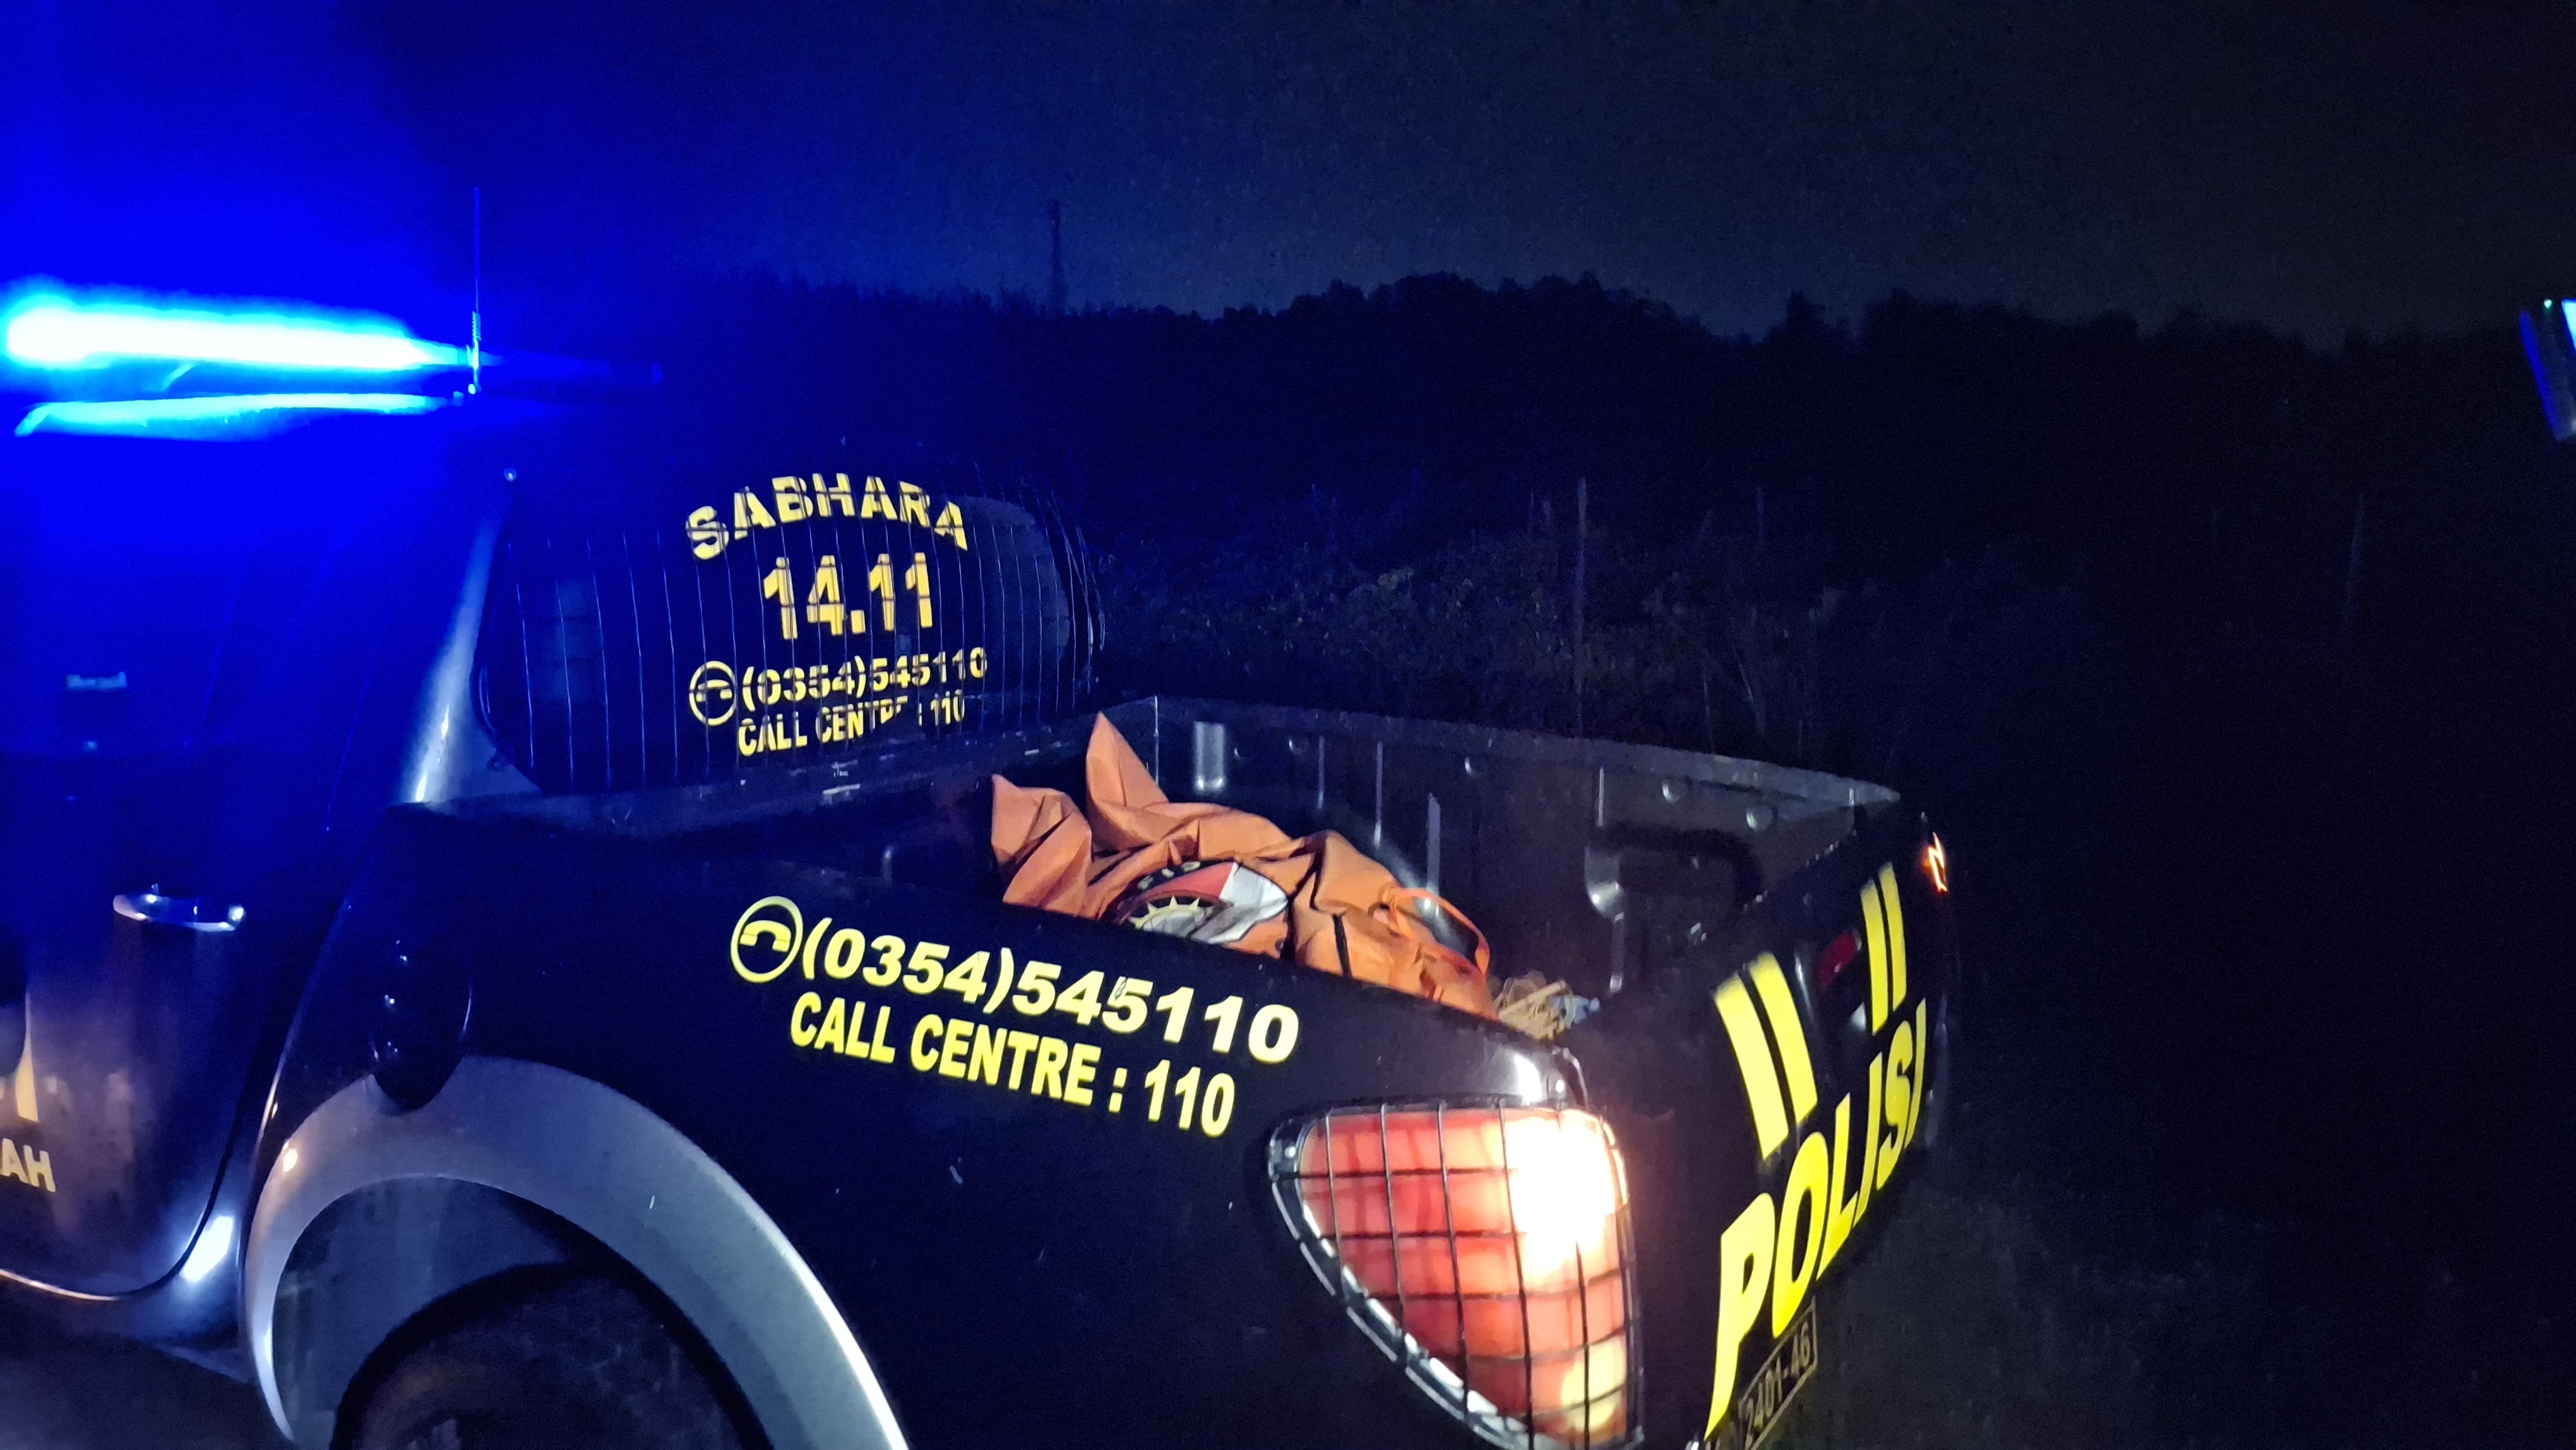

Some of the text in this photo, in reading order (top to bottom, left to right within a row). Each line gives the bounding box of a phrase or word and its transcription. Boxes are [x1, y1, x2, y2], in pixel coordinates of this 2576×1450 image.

[686, 473, 968, 560] SABHARA
[763, 552, 933, 640] 14.11
[738, 714, 808, 757] CALL
[930, 688, 965, 727] 110
[742, 647, 988, 712] (0354)545110
[802, 917, 1299, 1064] (0354)545110
[790, 992, 897, 1064] CALL
[910, 1012, 1102, 1106] CENTRE
[1143, 1058, 1236, 1137] 110
[1703, 997, 1927, 1441] POLISI
